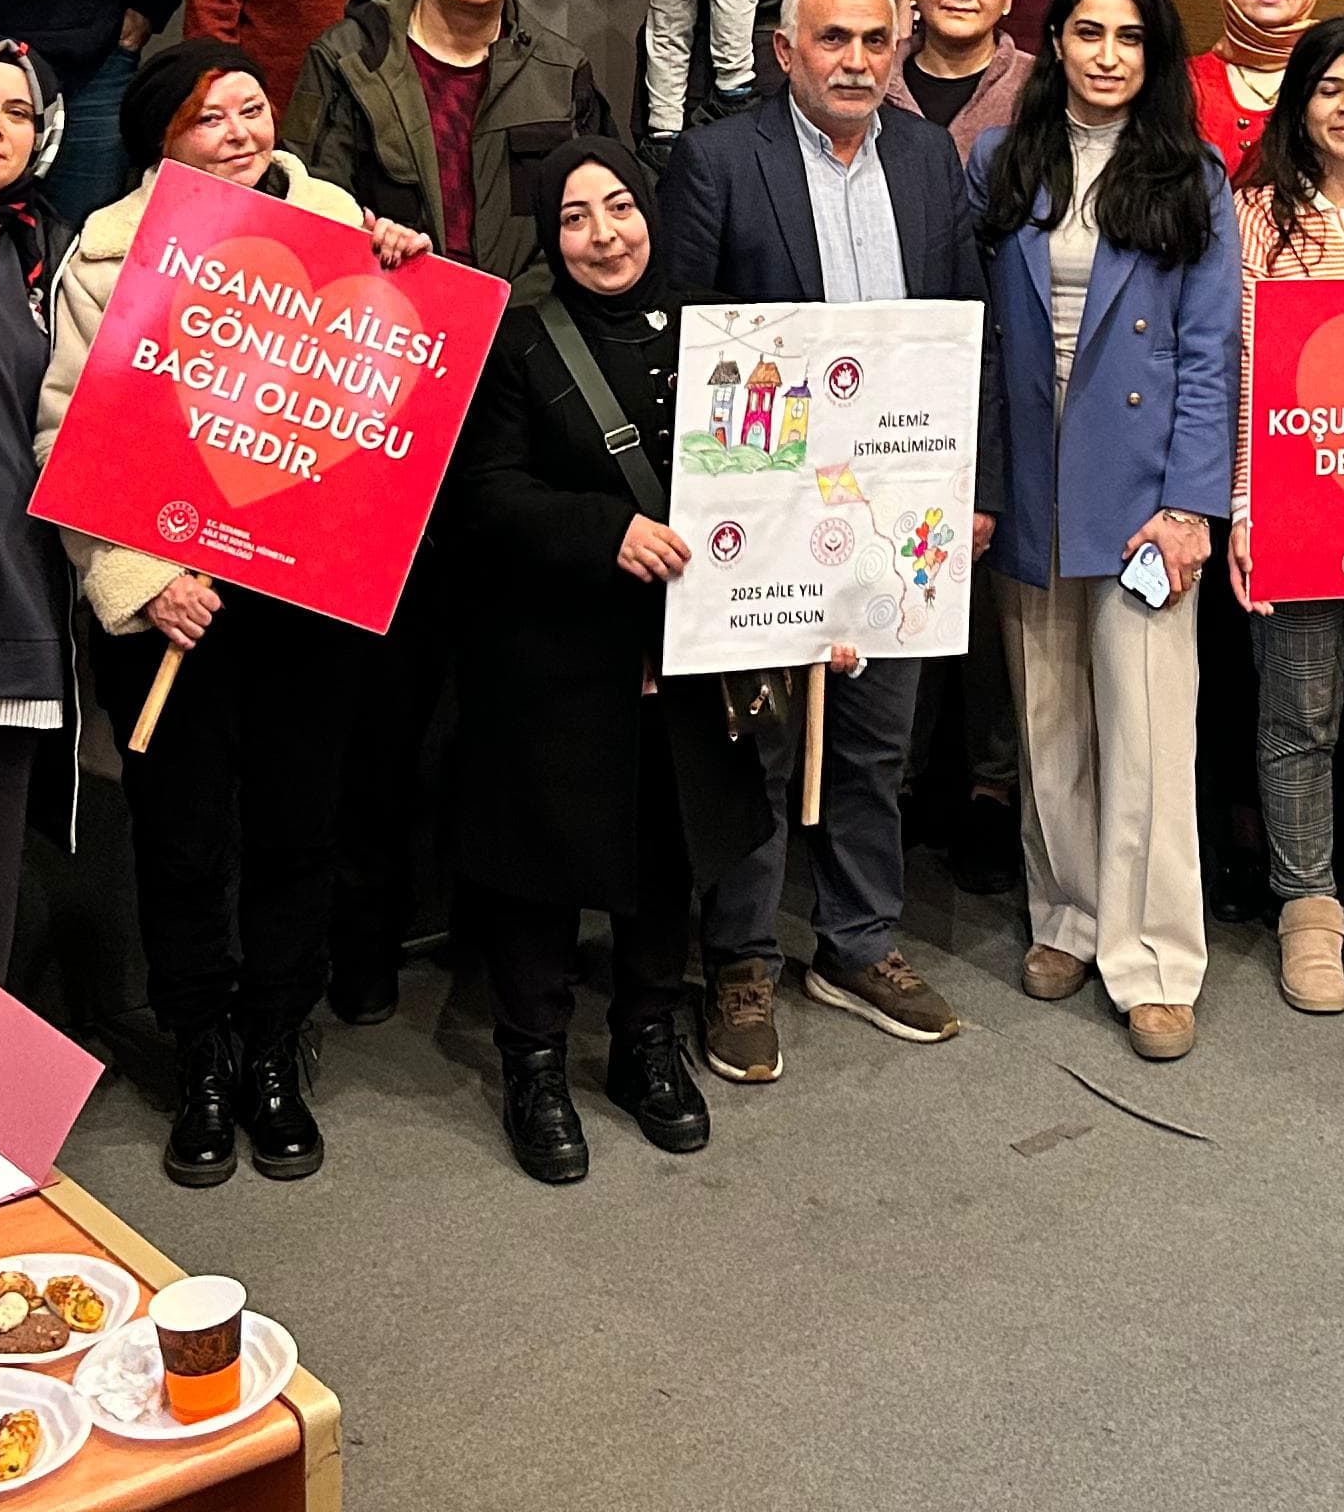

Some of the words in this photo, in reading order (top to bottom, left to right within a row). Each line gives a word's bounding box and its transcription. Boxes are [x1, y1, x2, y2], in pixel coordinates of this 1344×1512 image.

[156, 235, 323, 327] İNSANIN
[325, 305, 448, 379] AİLESİ,
[179, 304, 402, 407] GÖNLÜNÜN
[131, 337, 244, 402] BAĞLI
[253, 381, 414, 460] OLDUĞU
[878, 410, 930, 429] AİLEMİZ
[188, 406, 322, 483] YERDİR.
[854, 435, 957, 457] İSTİKBALİMİZDİR
[730, 587, 762, 601] 2025
[766, 582, 794, 599] AİLE
[799, 583, 824, 598] YILI
[730, 612, 773, 628] KUTLU
[777, 610, 825, 625] OLSUN
